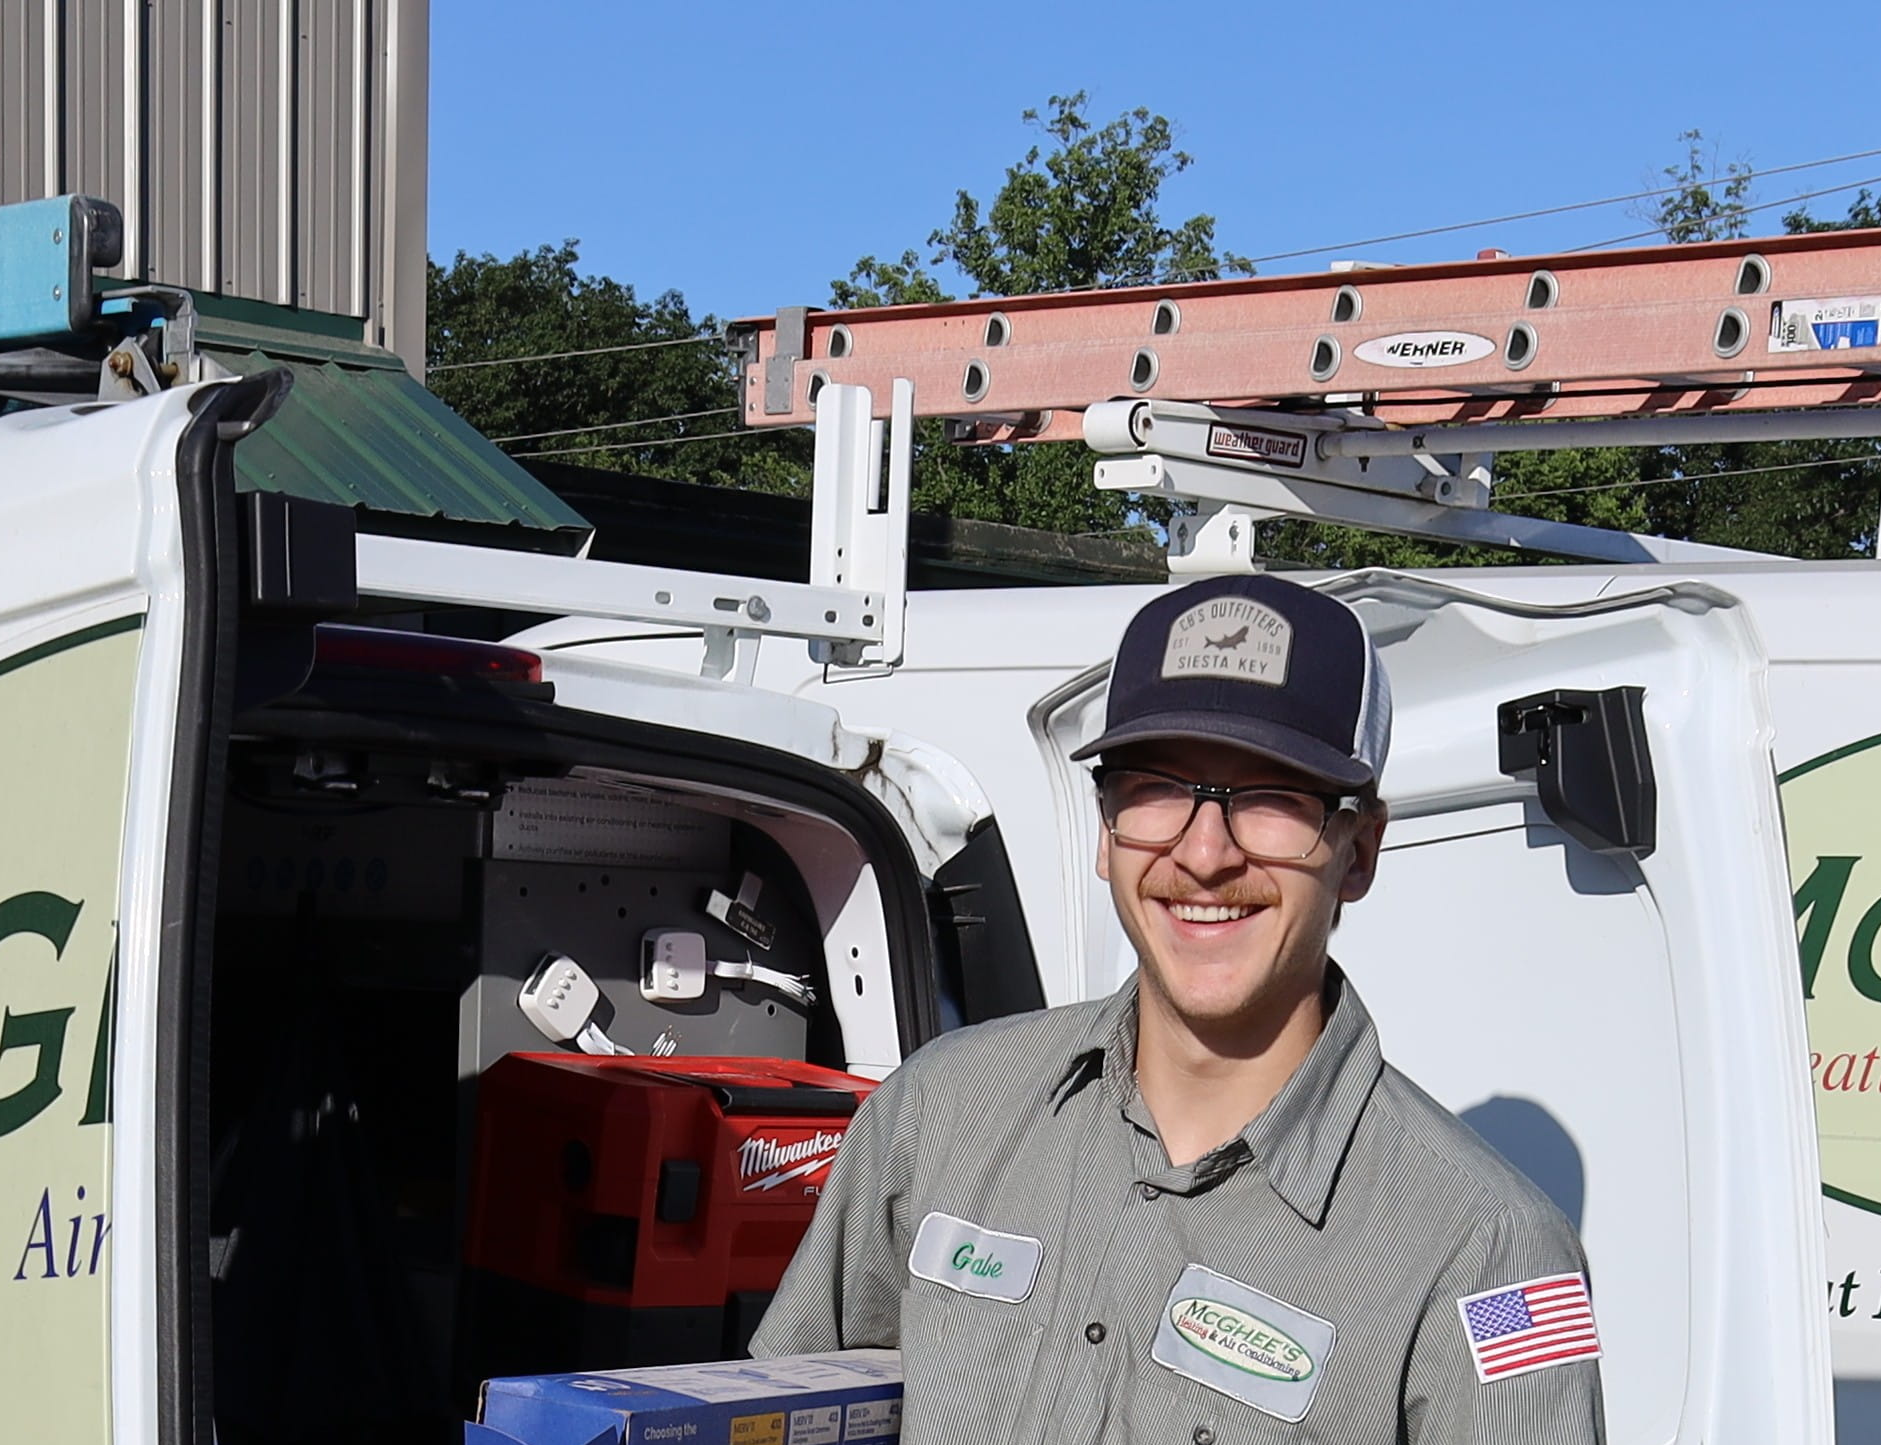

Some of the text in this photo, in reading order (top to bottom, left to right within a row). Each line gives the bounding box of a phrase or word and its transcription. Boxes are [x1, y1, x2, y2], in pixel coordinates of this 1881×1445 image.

[1386, 341, 1466, 357] WERNER
[1214, 430, 1300, 457] weather guard
[1179, 601, 1284, 637] CB'S OUTFITTERS
[1178, 654, 1269, 674] SIESTA KEY
[738, 1131, 843, 1180] Milwaukee
[952, 1242, 1003, 1278] Gabe
[1177, 1314, 1210, 1340] Heating
[1219, 1332, 1236, 1350] Air
[1238, 1343, 1301, 1381] Conditioning
[644, 1421, 697, 1441] Choosing the
